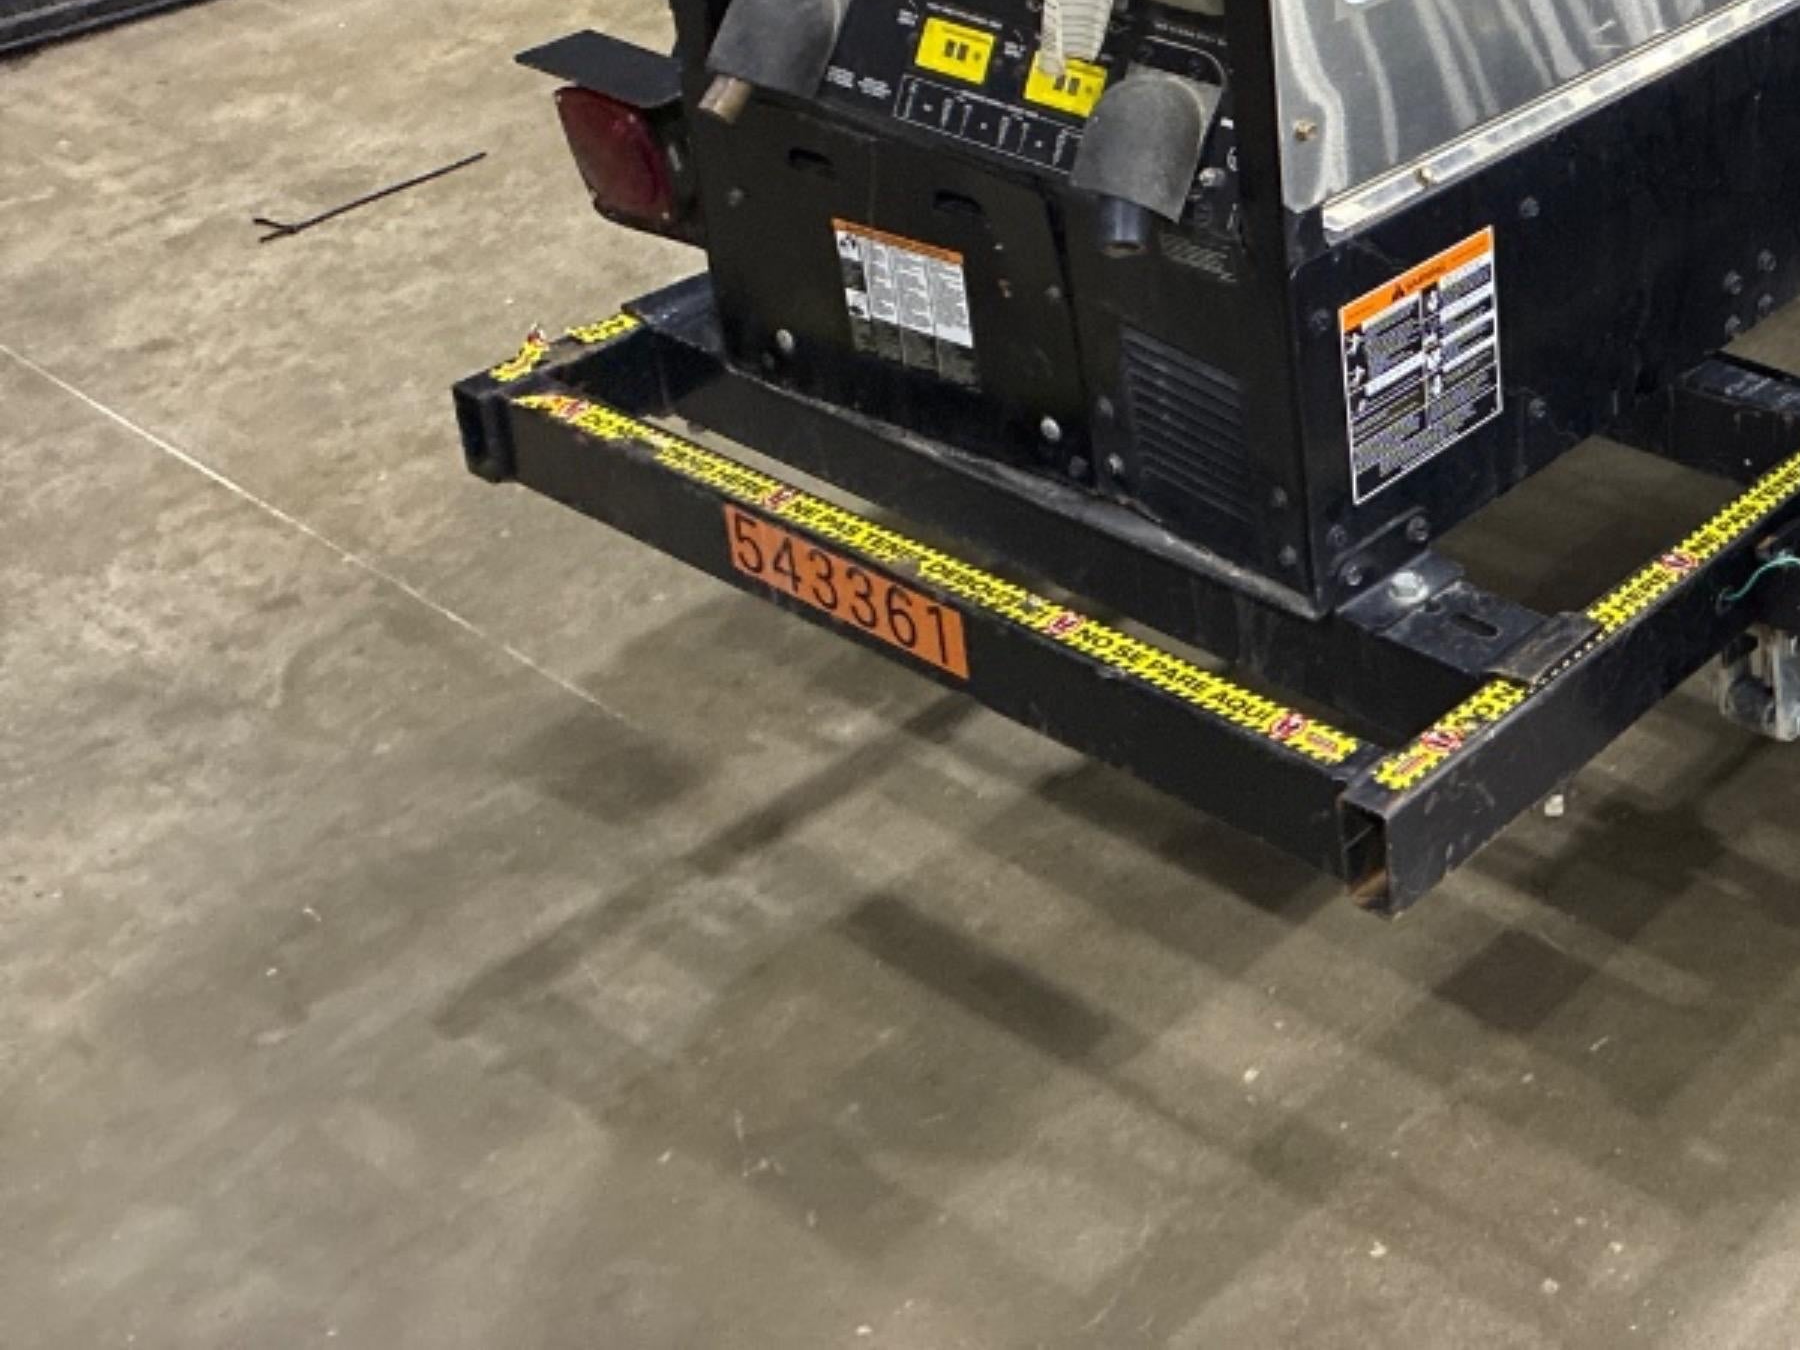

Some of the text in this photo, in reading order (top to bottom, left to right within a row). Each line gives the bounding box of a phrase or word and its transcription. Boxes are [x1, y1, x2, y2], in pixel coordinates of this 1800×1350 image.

[736, 517, 951, 665] 543361
[1076, 626, 1113, 649] NO
[1113, 639, 1147, 664] SE
[1147, 658, 1211, 693] PARE
